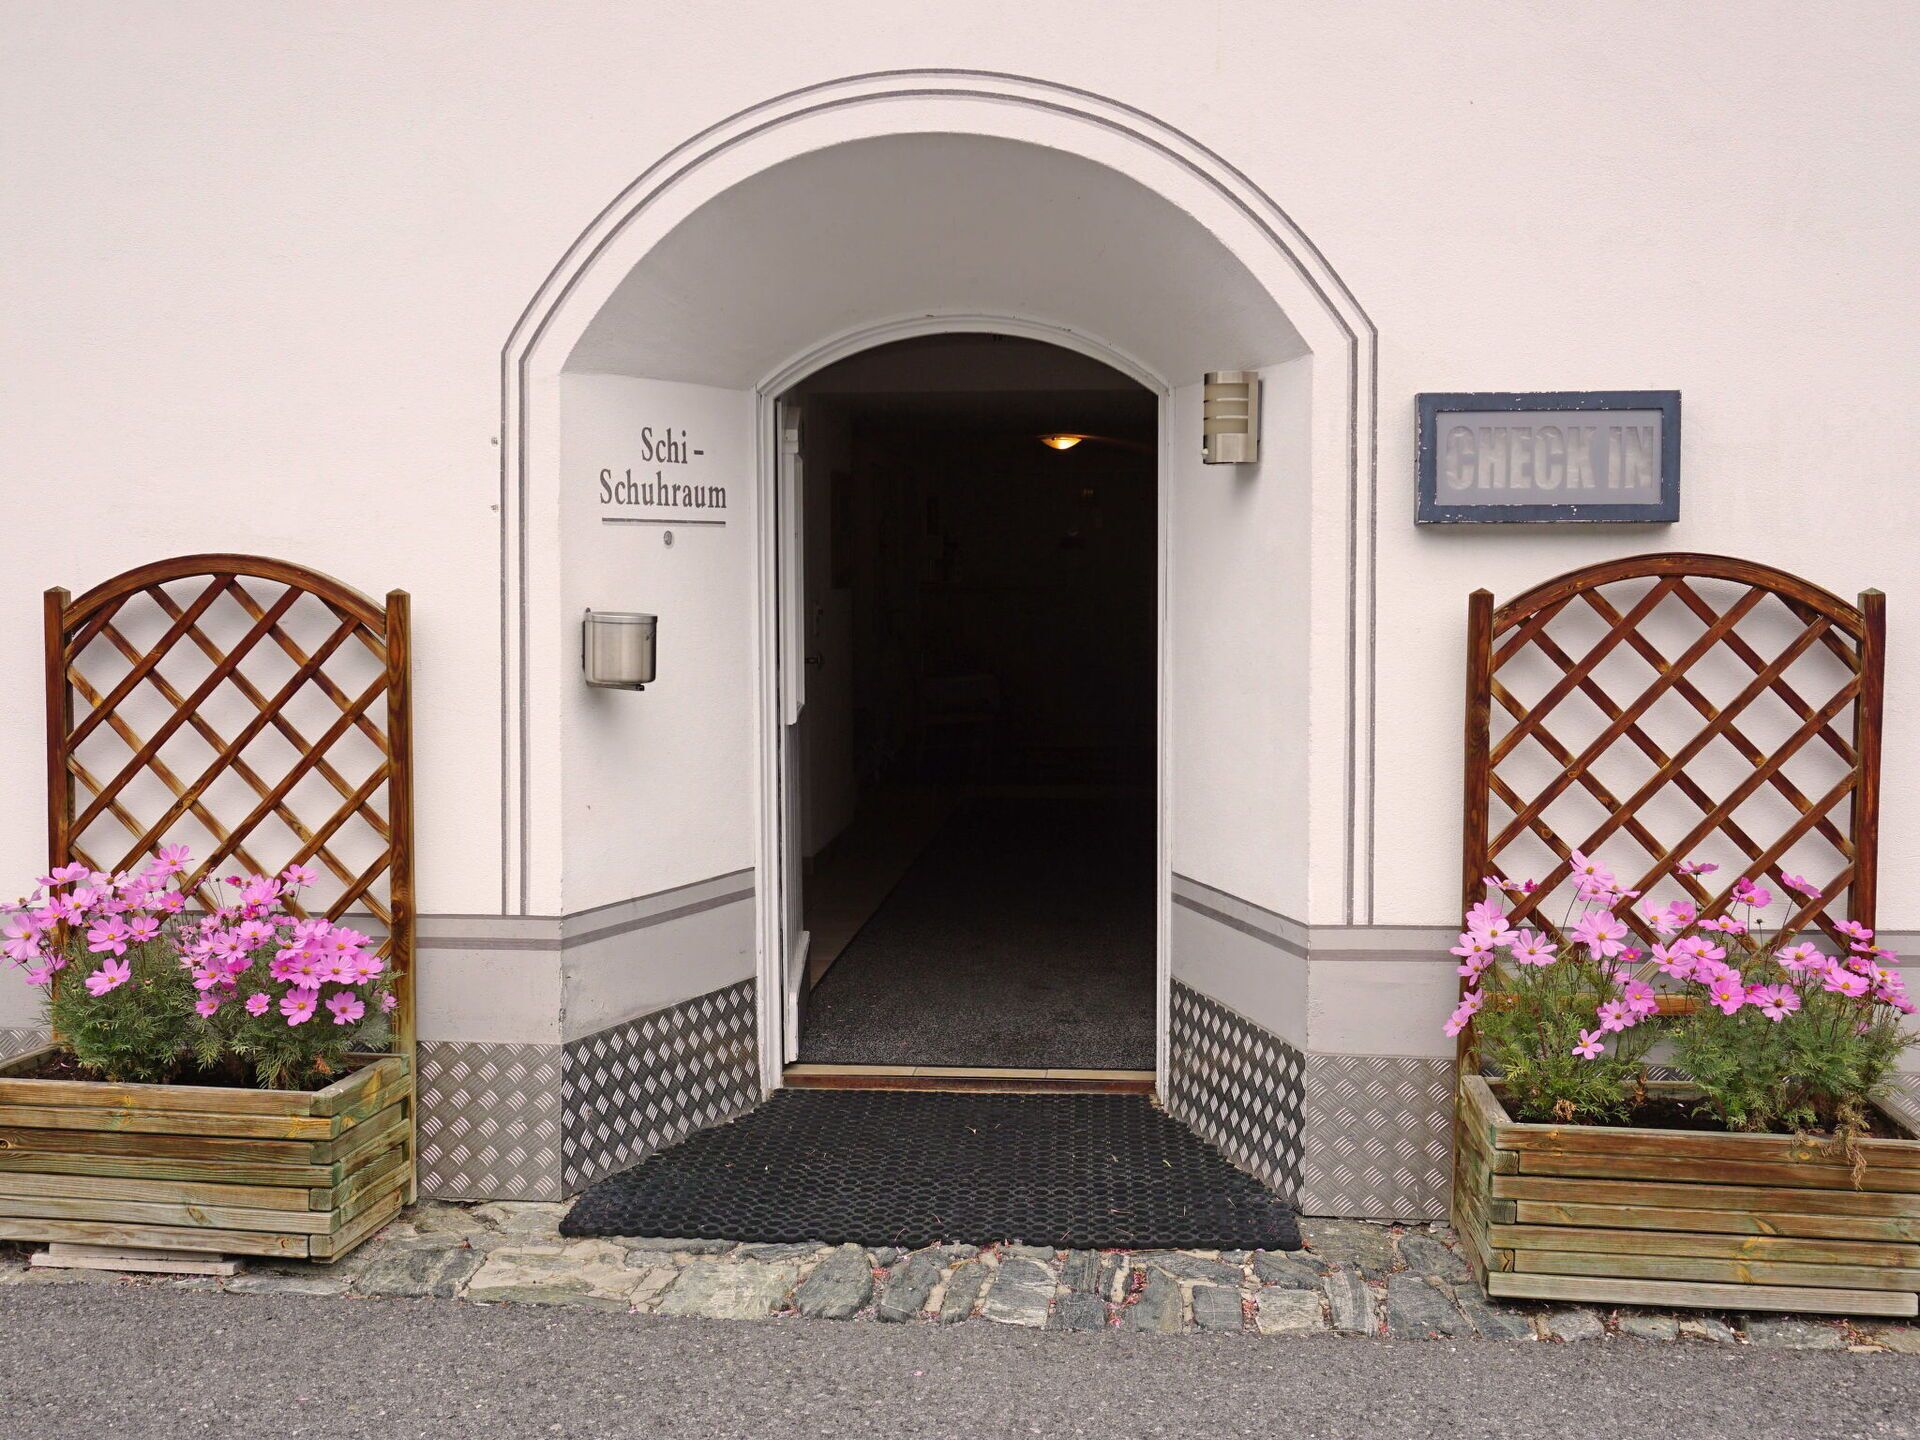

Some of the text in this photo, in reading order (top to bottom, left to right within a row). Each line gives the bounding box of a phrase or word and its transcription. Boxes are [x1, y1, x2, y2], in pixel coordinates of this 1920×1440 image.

[1446, 426, 1655, 490] CHECK IN
[600, 469, 727, 509] Schuhraum
